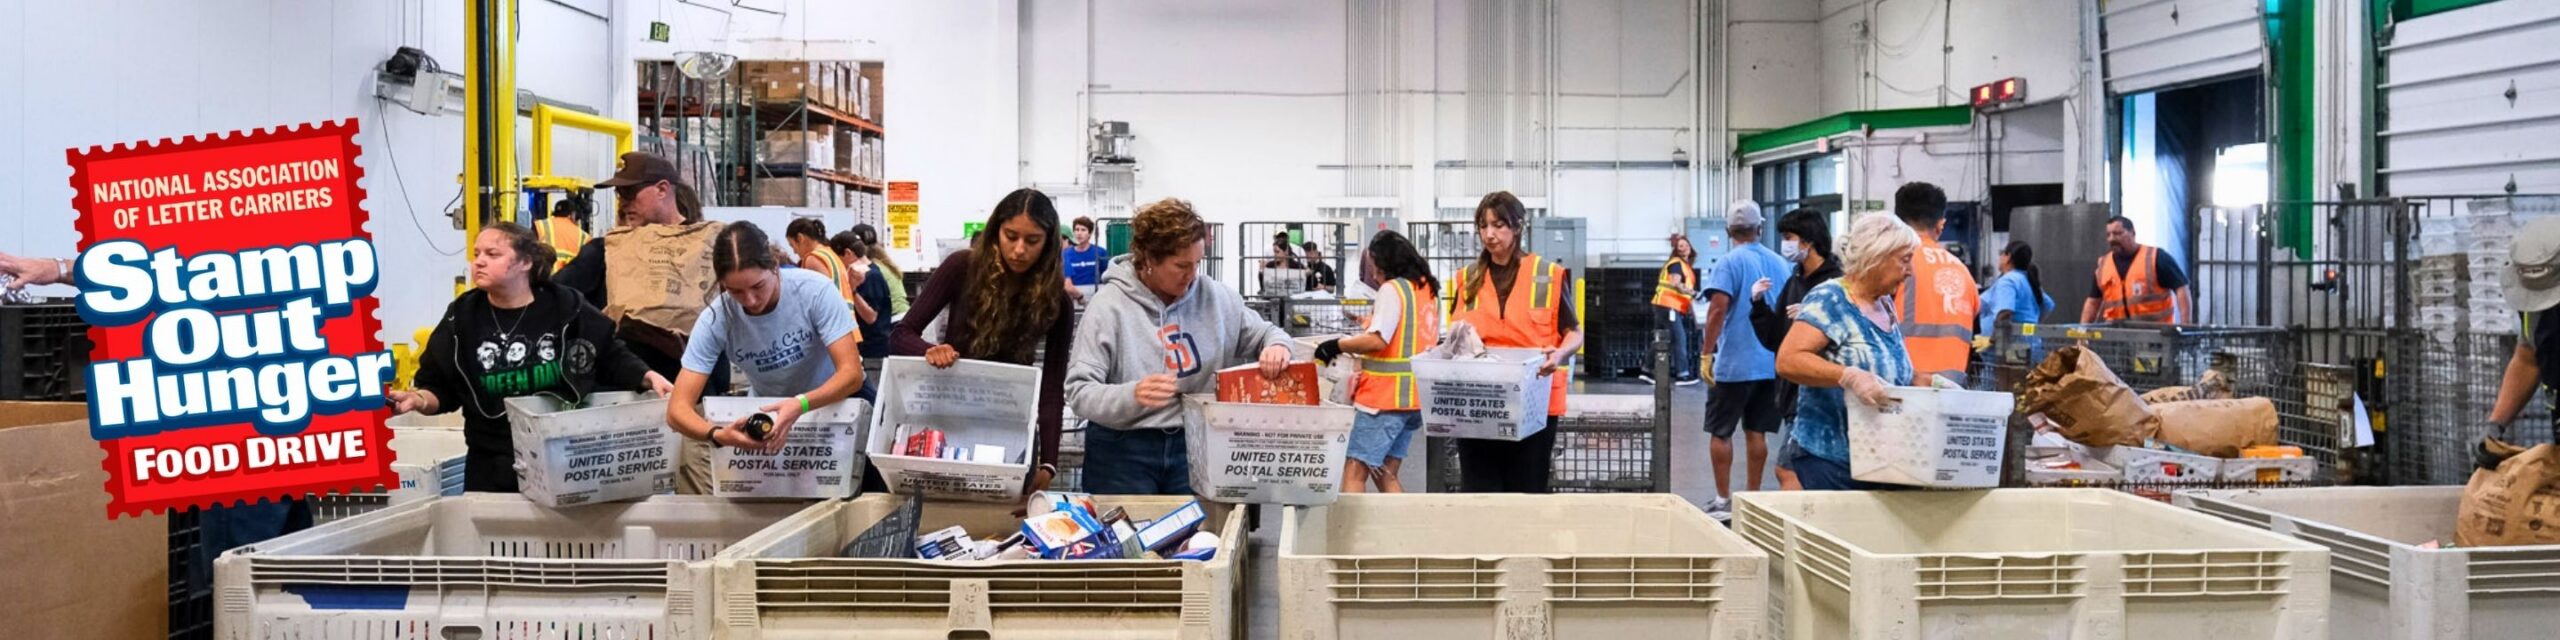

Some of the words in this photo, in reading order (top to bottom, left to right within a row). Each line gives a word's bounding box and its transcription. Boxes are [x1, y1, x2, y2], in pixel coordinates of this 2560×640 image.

[735, 341, 781, 362] Smash
[782, 328, 813, 346] City
[1434, 397, 1467, 406] UNITED
[1469, 399, 1506, 409] STATES
[1431, 407, 1467, 417] POSTAL
[1469, 409, 1509, 419] SERVICE
[1946, 435, 1971, 446] UNITED
[1971, 436, 1997, 447] STATES
[569, 453, 614, 469] UNITED
[617, 446, 663, 462] STATES
[783, 446, 832, 457] STATES
[1231, 451, 1276, 462] UNITED
[1279, 452, 1326, 464] STATES
[1942, 448, 1969, 459] POSTAL
[1970, 450, 1998, 461] SERVICE
[564, 467, 614, 483] POSTAL
[617, 459, 669, 475] SERVICE
[728, 460, 778, 470] POSTAL
[782, 460, 838, 470] SERVICE
[1225, 464, 1273, 476] POSTAL
[1277, 466, 1329, 477] SERVICE
[401, 480, 416, 488] TM
[903, 477, 949, 487] UNITED
[953, 481, 1001, 489] STATES
